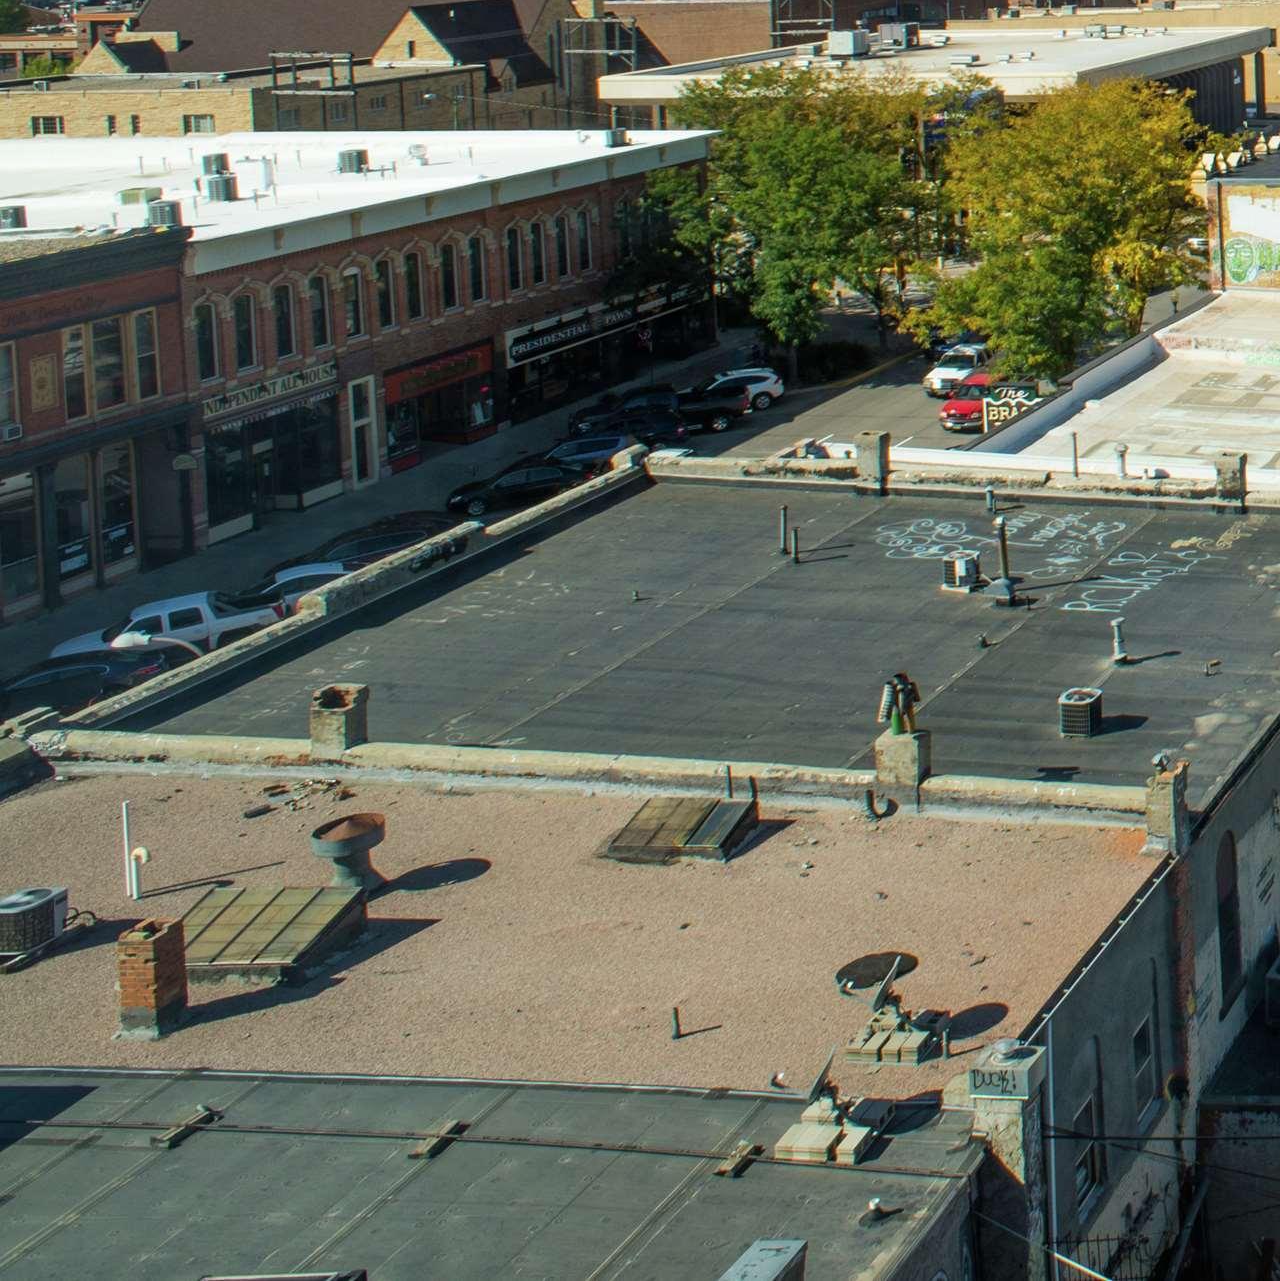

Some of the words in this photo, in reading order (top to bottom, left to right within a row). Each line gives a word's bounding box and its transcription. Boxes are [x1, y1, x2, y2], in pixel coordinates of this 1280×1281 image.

[511, 324, 592, 355] PRESIDENTIAL
[605, 309, 633, 326] PAWN
[994, 386, 1030, 399] The
[988, 405, 1028, 421] BRA
